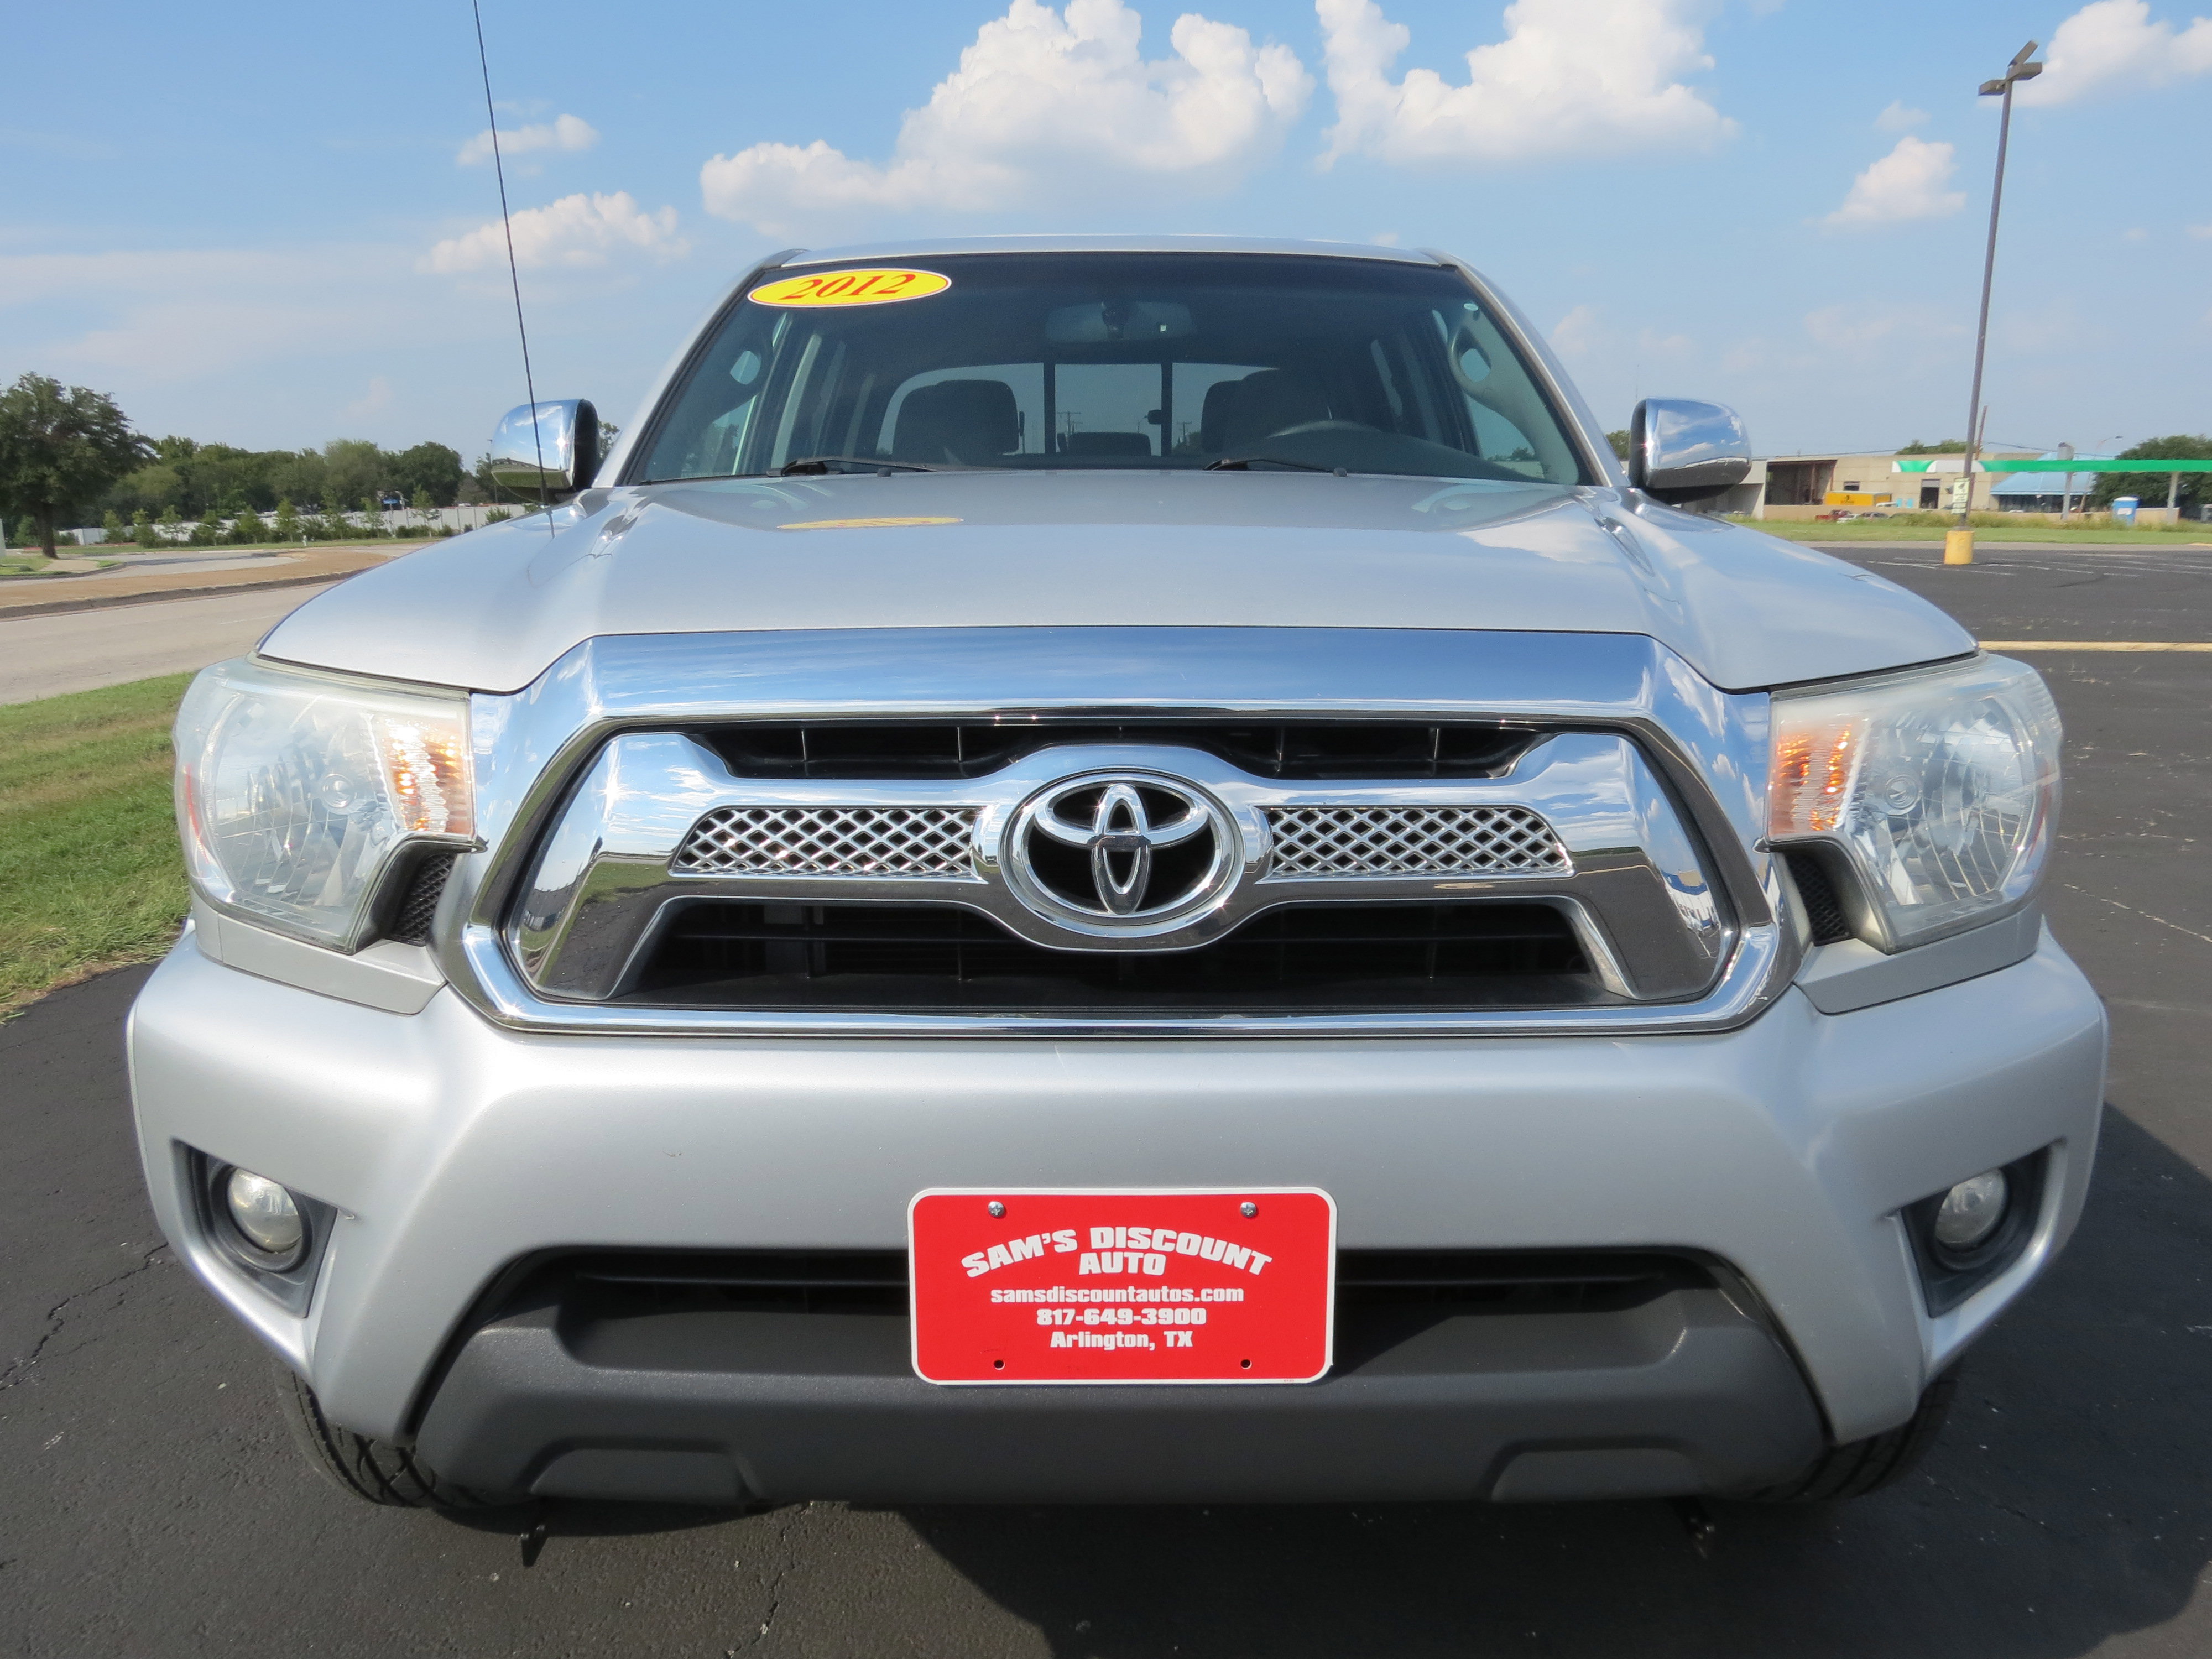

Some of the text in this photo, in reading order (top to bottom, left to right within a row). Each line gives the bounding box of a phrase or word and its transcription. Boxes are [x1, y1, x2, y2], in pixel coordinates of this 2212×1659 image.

[778, 274, 916, 300] 2012
[961, 1226, 1273, 1278] SAM'S DISCOUNT
[1079, 1251, 1167, 1276] AUTO
[990, 1285, 1244, 1303] samsdiscountautos.com
[1036, 1307, 1207, 1326] 817-649-3900
[1050, 1330, 1193, 1351] Arlington, TX
